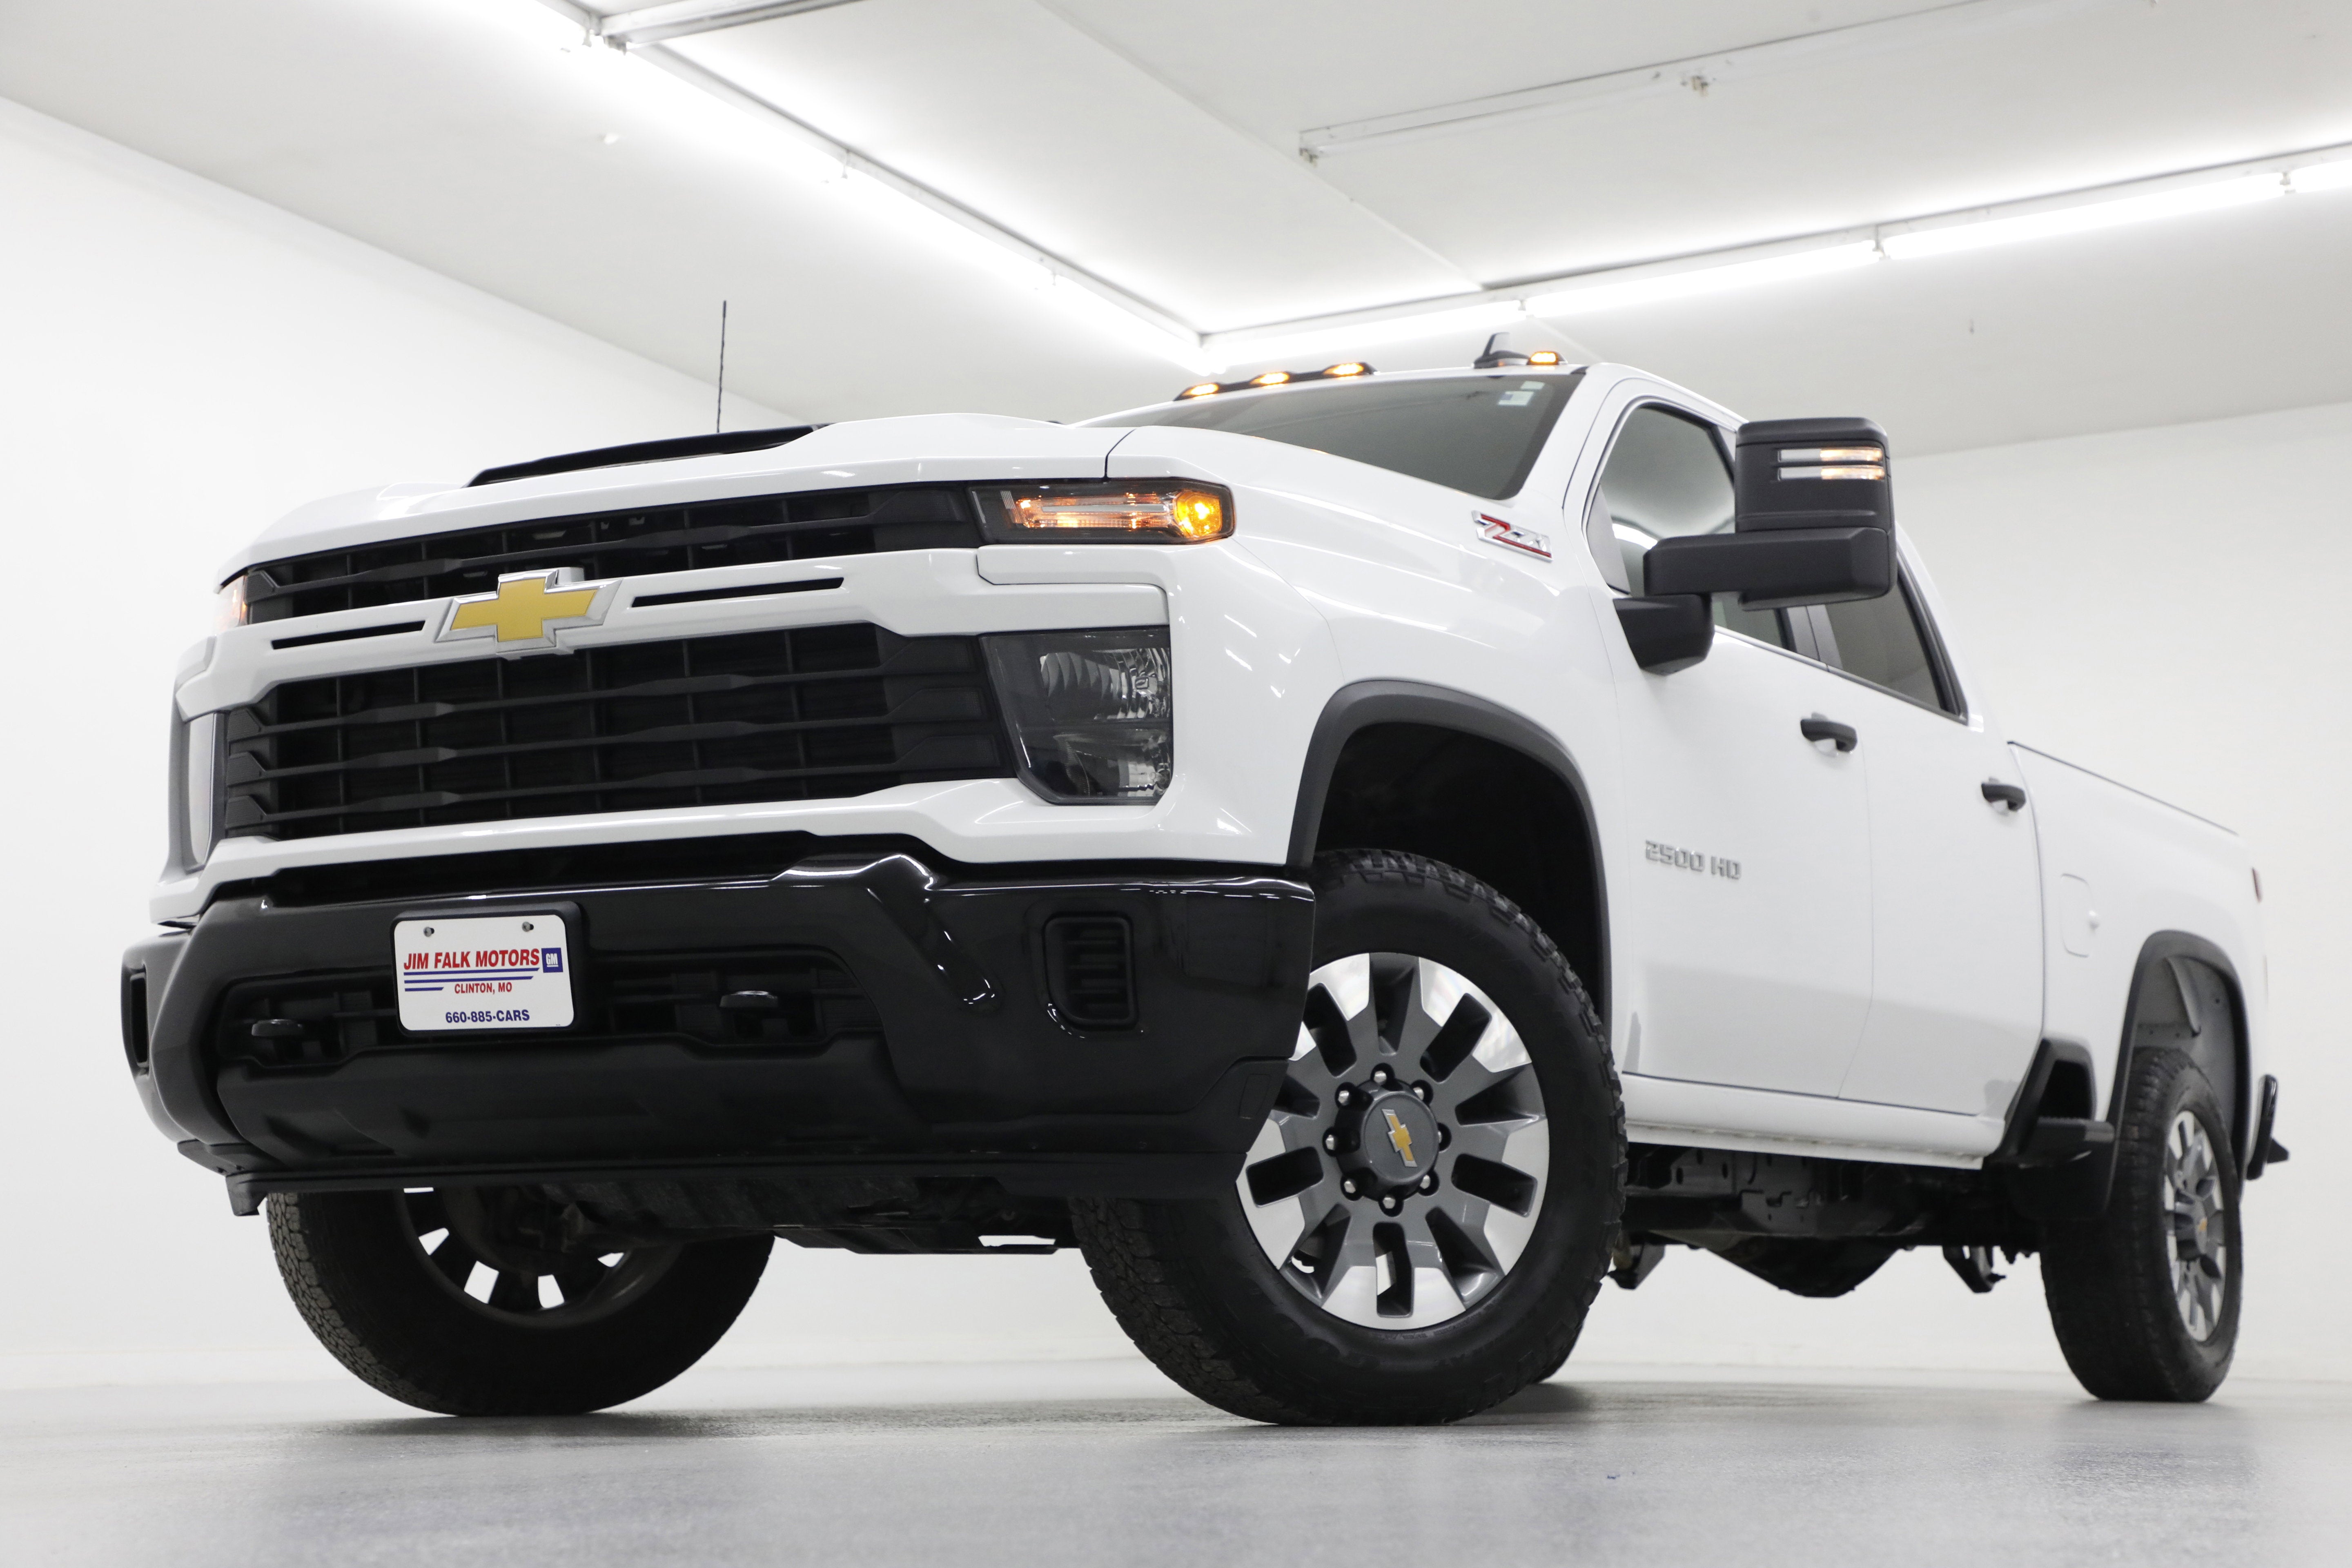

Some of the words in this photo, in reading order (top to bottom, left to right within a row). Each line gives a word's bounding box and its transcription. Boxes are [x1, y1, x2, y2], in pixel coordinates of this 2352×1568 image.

[1645, 840, 1705, 872] 2500
[1711, 855, 1742, 880] HD
[404, 953, 429, 970] JIM
[434, 951, 470, 969] FALK
[475, 948, 540, 968] MOTORS
[545, 953, 558, 965] GM
[454, 982, 495, 995] CLINTON,
[498, 982, 512, 993] MO
[445, 1009, 530, 1023] 660-885-CARS
